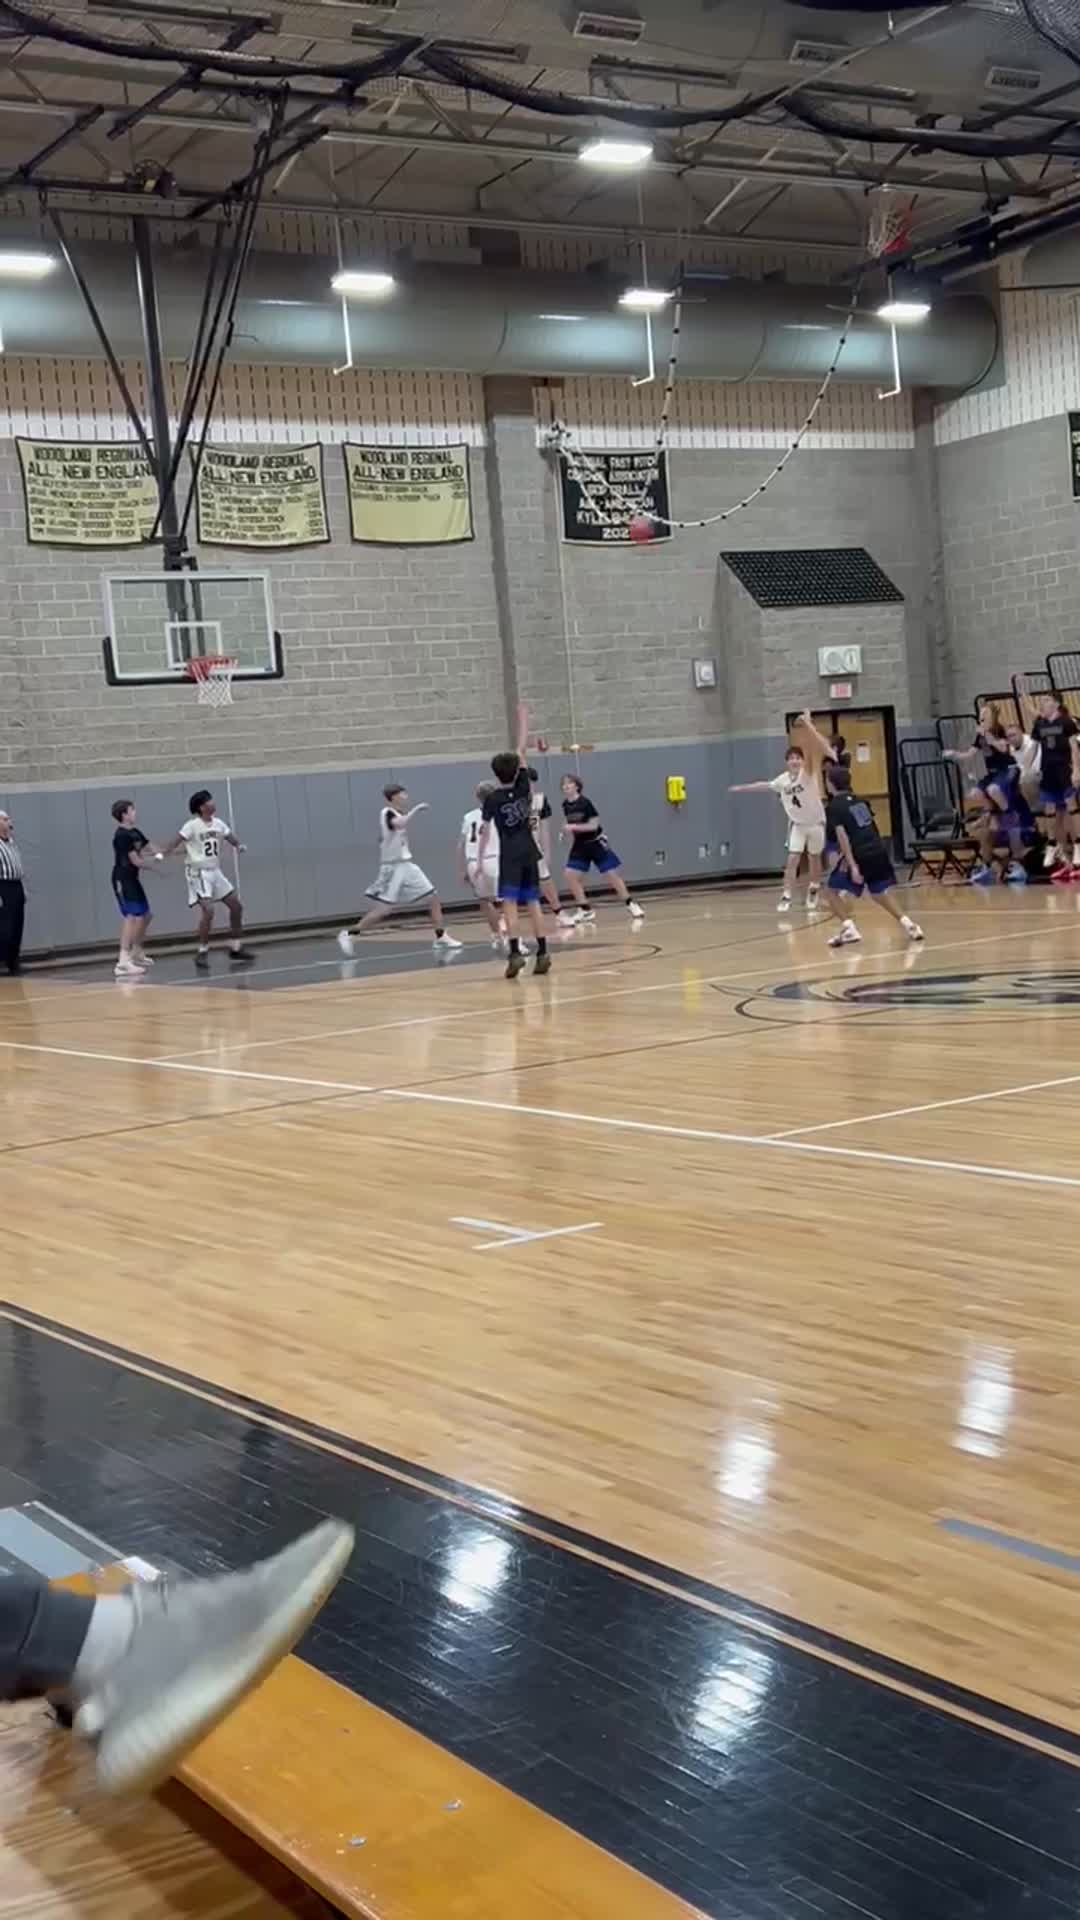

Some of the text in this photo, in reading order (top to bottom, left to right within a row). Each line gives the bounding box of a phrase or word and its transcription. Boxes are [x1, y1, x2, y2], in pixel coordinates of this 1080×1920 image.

[96, 464, 152, 478] ENGLAN
[260, 465, 317, 483] ENGLAND
[410, 465, 464, 480] ENGLAND
[602, 527, 631, 539] 202
